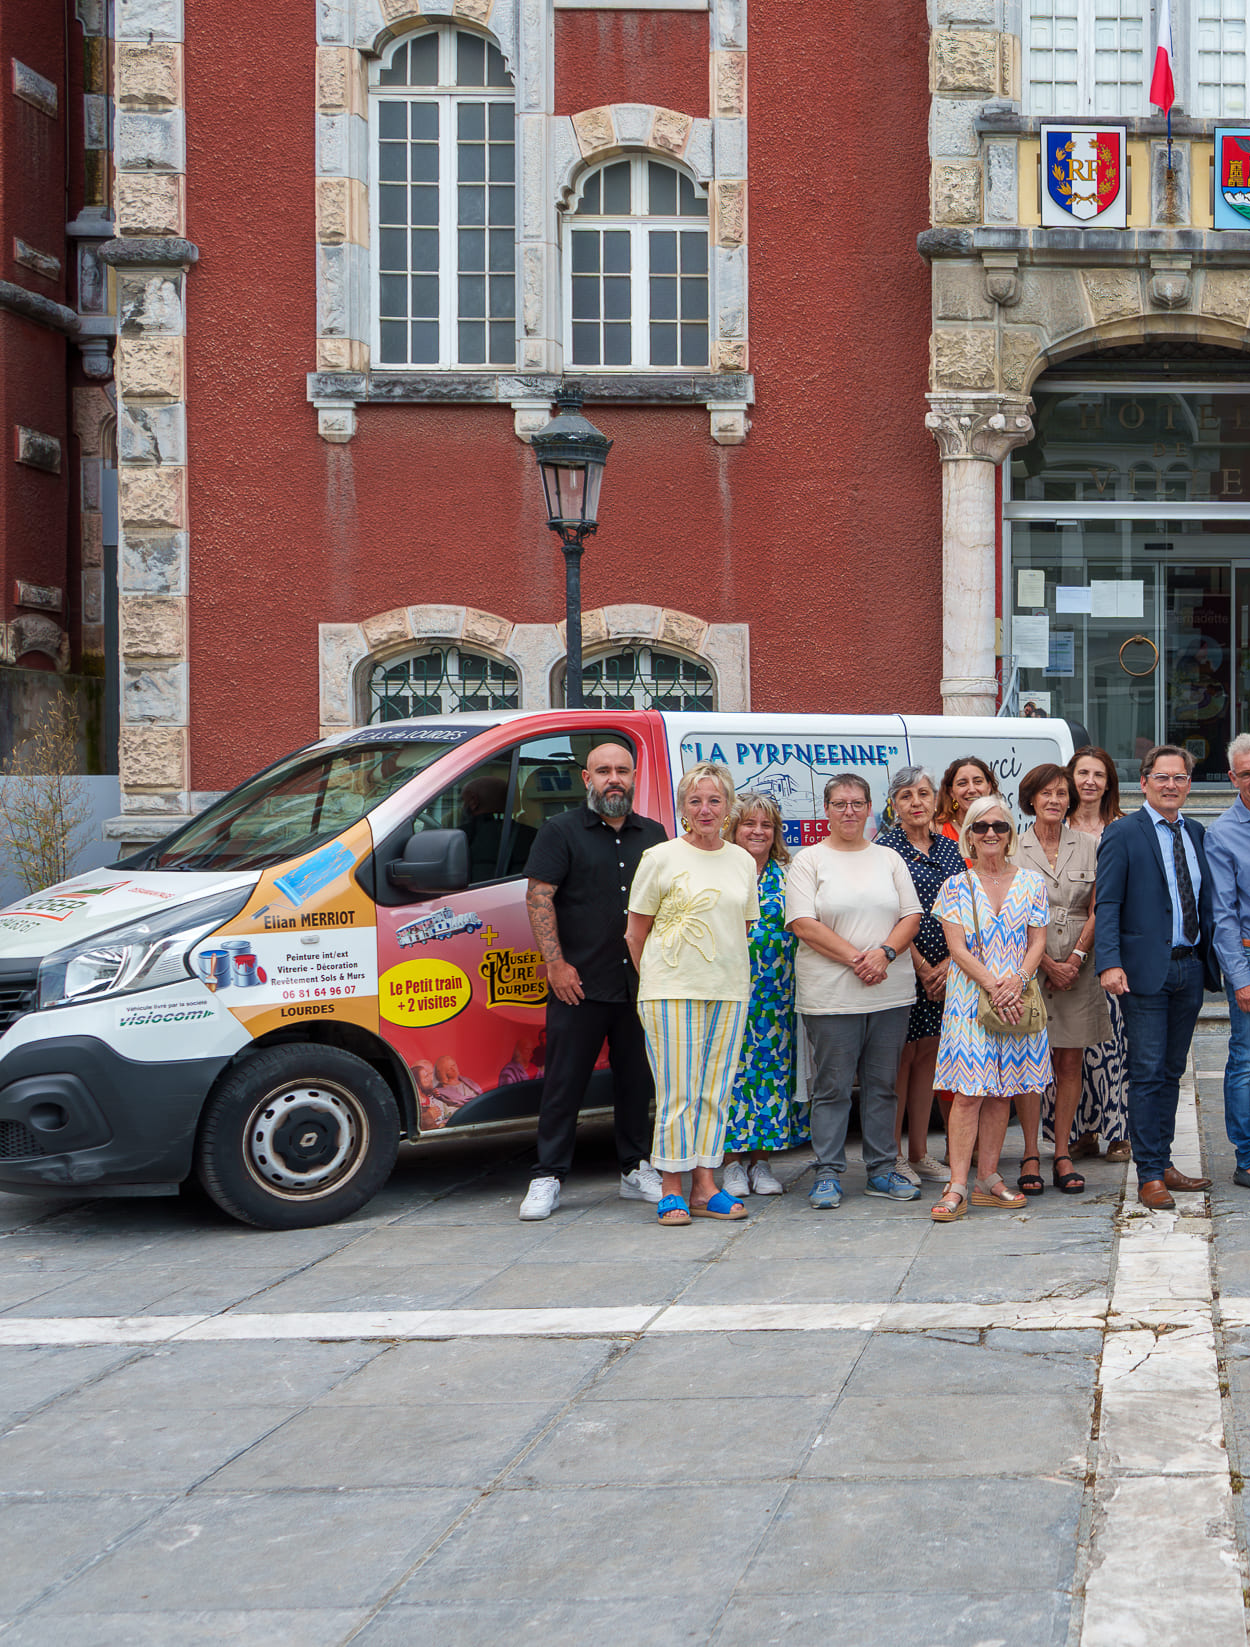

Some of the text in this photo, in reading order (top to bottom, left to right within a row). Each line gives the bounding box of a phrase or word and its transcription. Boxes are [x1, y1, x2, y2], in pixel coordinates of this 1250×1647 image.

[1066, 159, 1101, 181] RF
[1152, 443, 1188, 457] DE
[1088, 468, 1243, 494] VILLE
[786, 835, 799, 843] de
[264, 911, 355, 929] Elian MERRIOT
[287, 951, 348, 961] Peinture int/ext
[278, 965, 308, 973] Vitrerie
[317, 962, 358, 971] Décoration
[283, 986, 356, 999] 06 81 64 96 07
[390, 976, 462, 996] Le Petit train
[281, 1004, 334, 1017] LOURDES
[408, 998, 415, 1012] 2
[417, 995, 456, 1011] visites
[120, 1010, 203, 1026] visiocom
